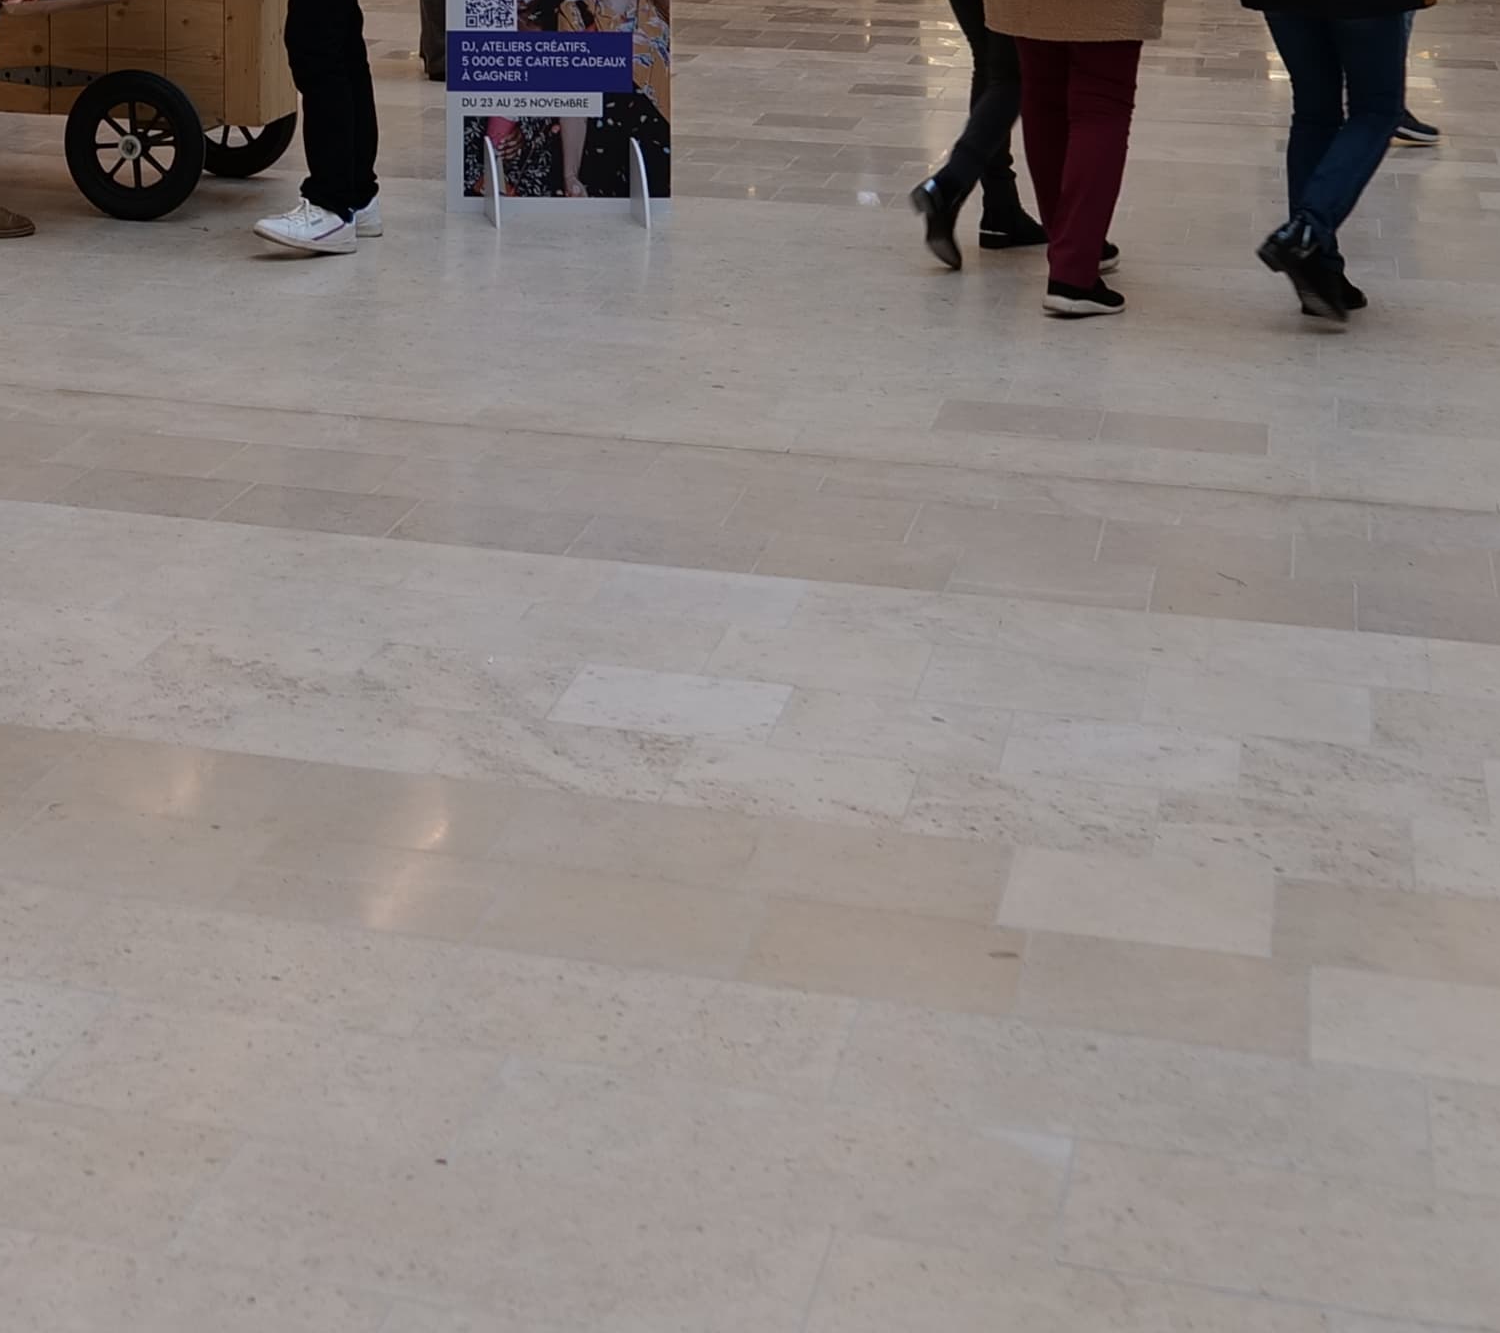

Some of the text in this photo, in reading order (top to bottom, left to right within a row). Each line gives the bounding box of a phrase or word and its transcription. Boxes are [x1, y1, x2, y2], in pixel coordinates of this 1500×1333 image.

[462, 39, 591, 54] DJ, ATELIERS CRÉATIFS,
[461, 56, 627, 68] 5 000€ DE CARTES CADEAUX
[461, 69, 471, 82] À
[473, 70, 522, 82] GAGNER
[461, 98, 589, 109] DU 23 AU 25 NOVEMBRE
